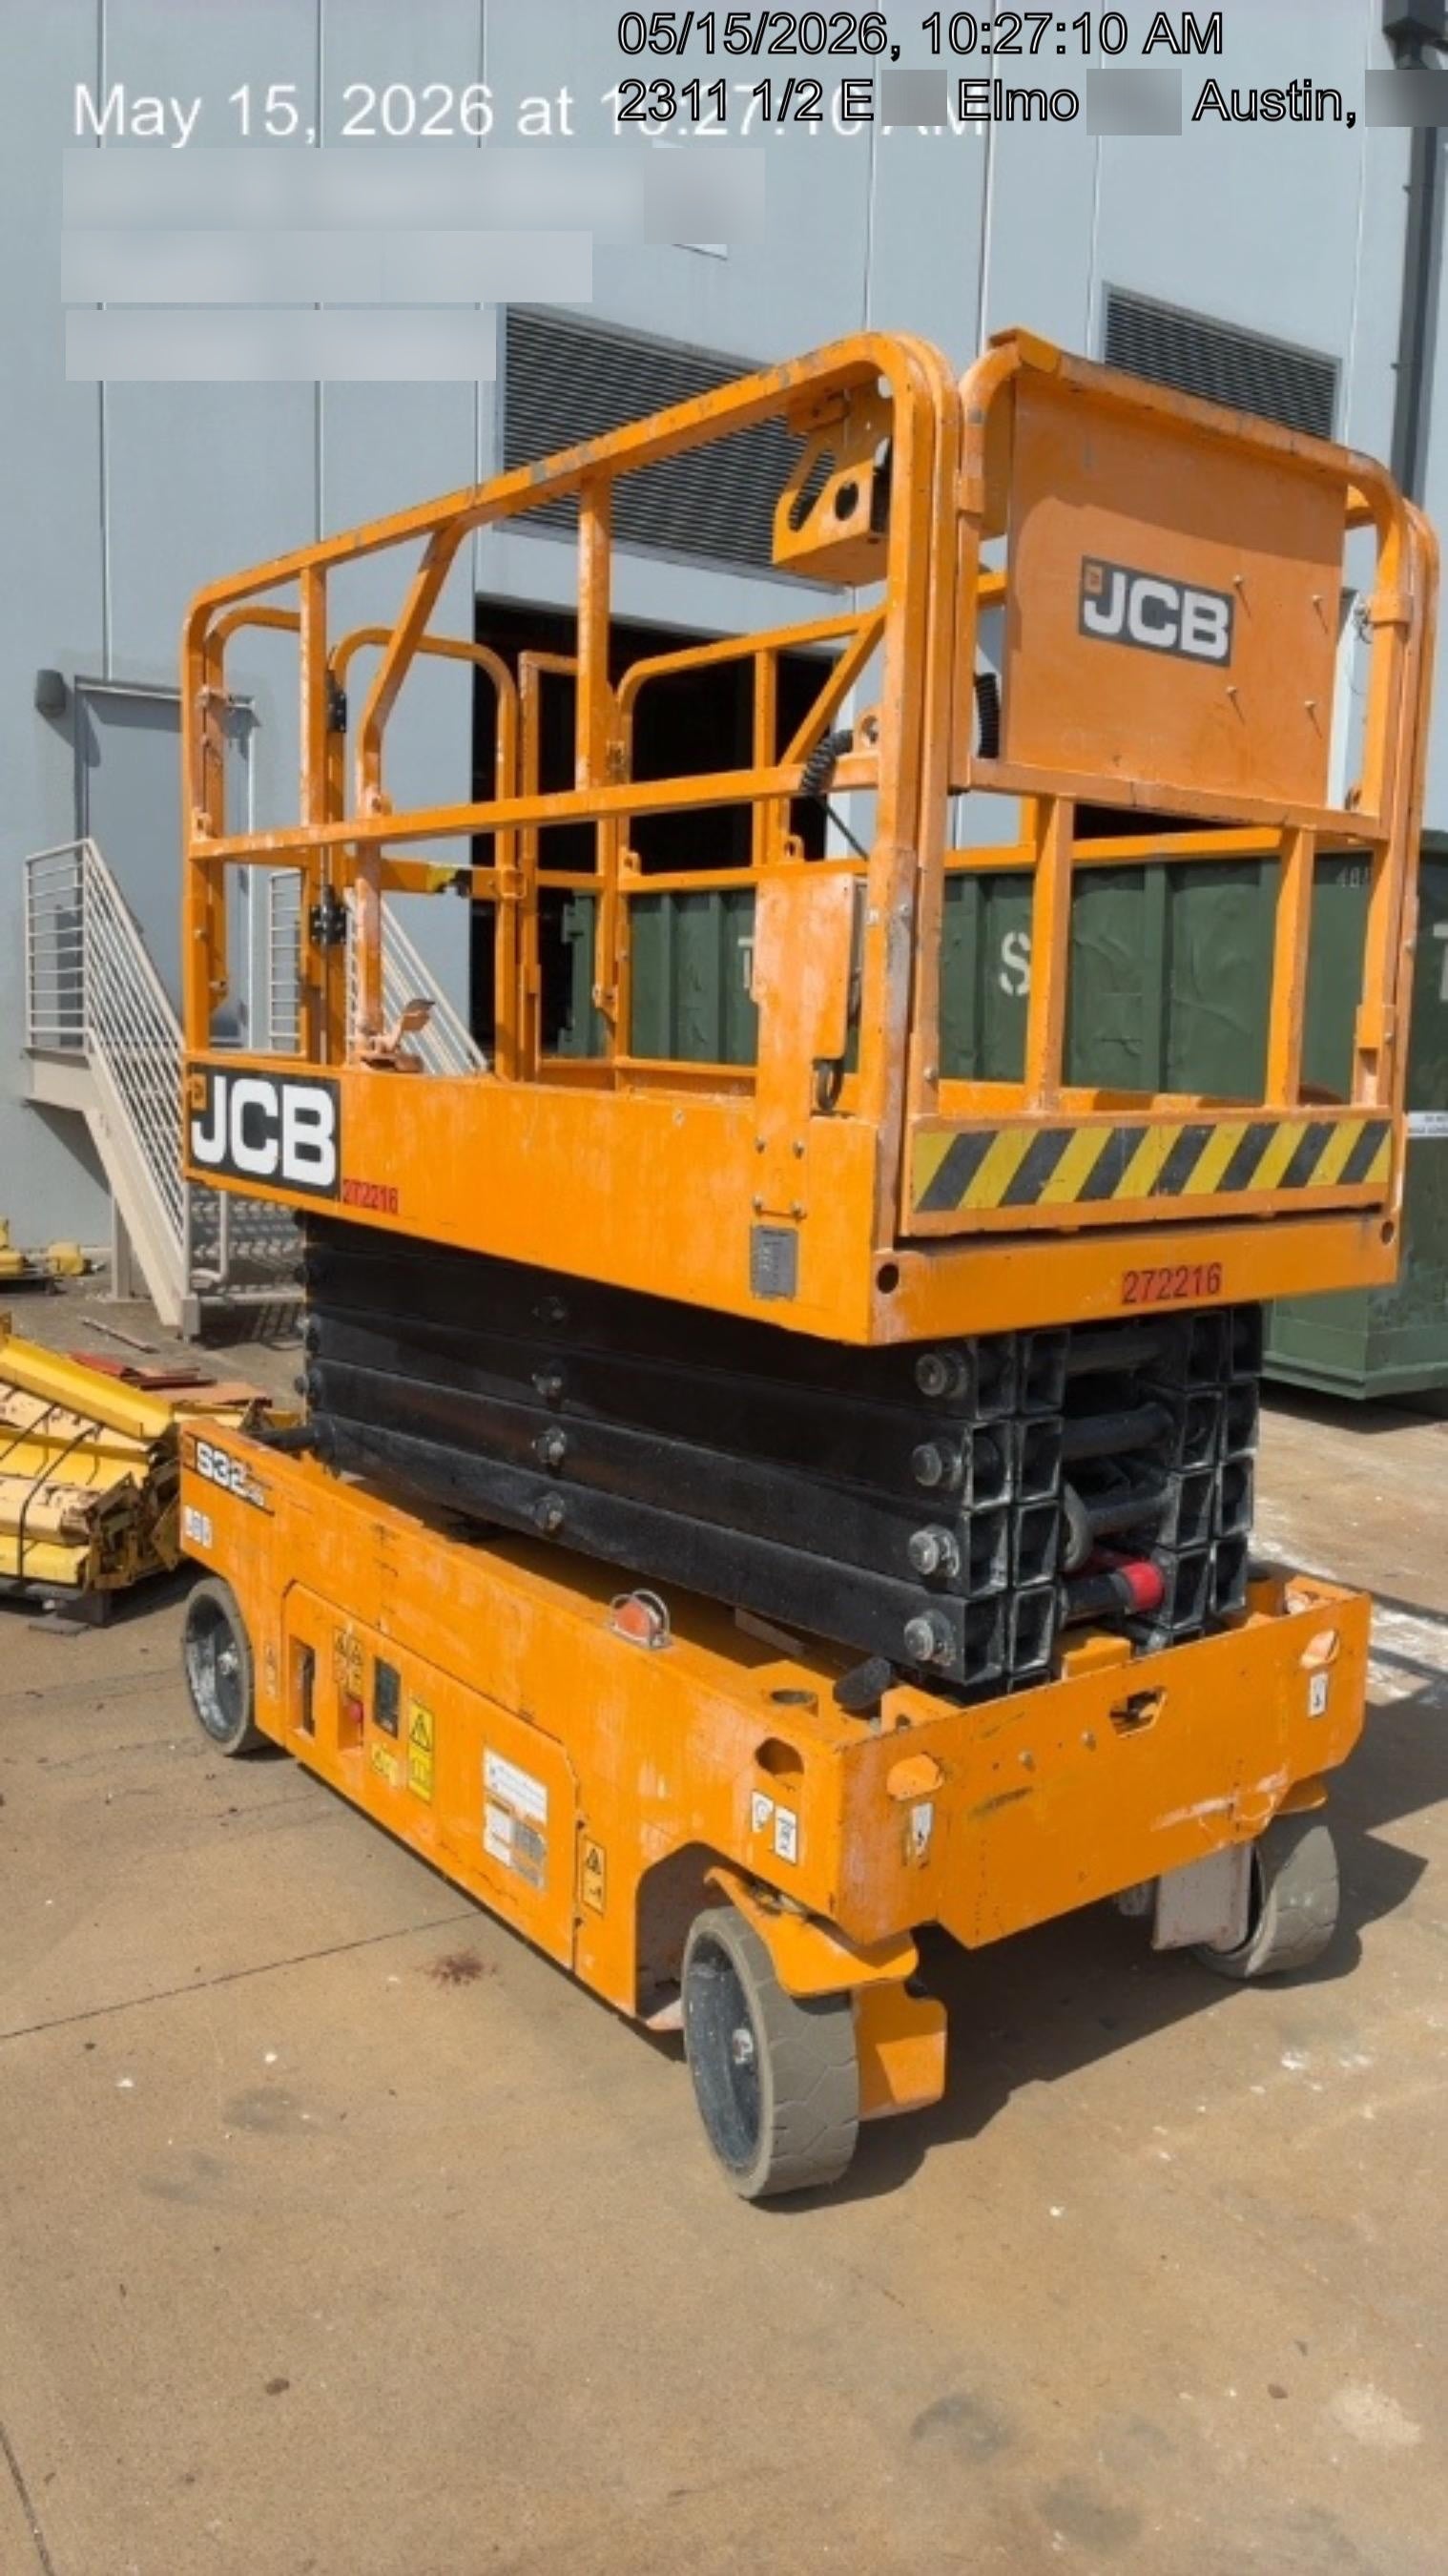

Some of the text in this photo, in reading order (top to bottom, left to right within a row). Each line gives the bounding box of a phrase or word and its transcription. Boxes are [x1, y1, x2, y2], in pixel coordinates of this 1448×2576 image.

[1083, 571, 1231, 659] JCB
[999, 930, 1032, 997] S
[191, 1075, 336, 1187] JCB
[1122, 1261, 1223, 1304] 272216
